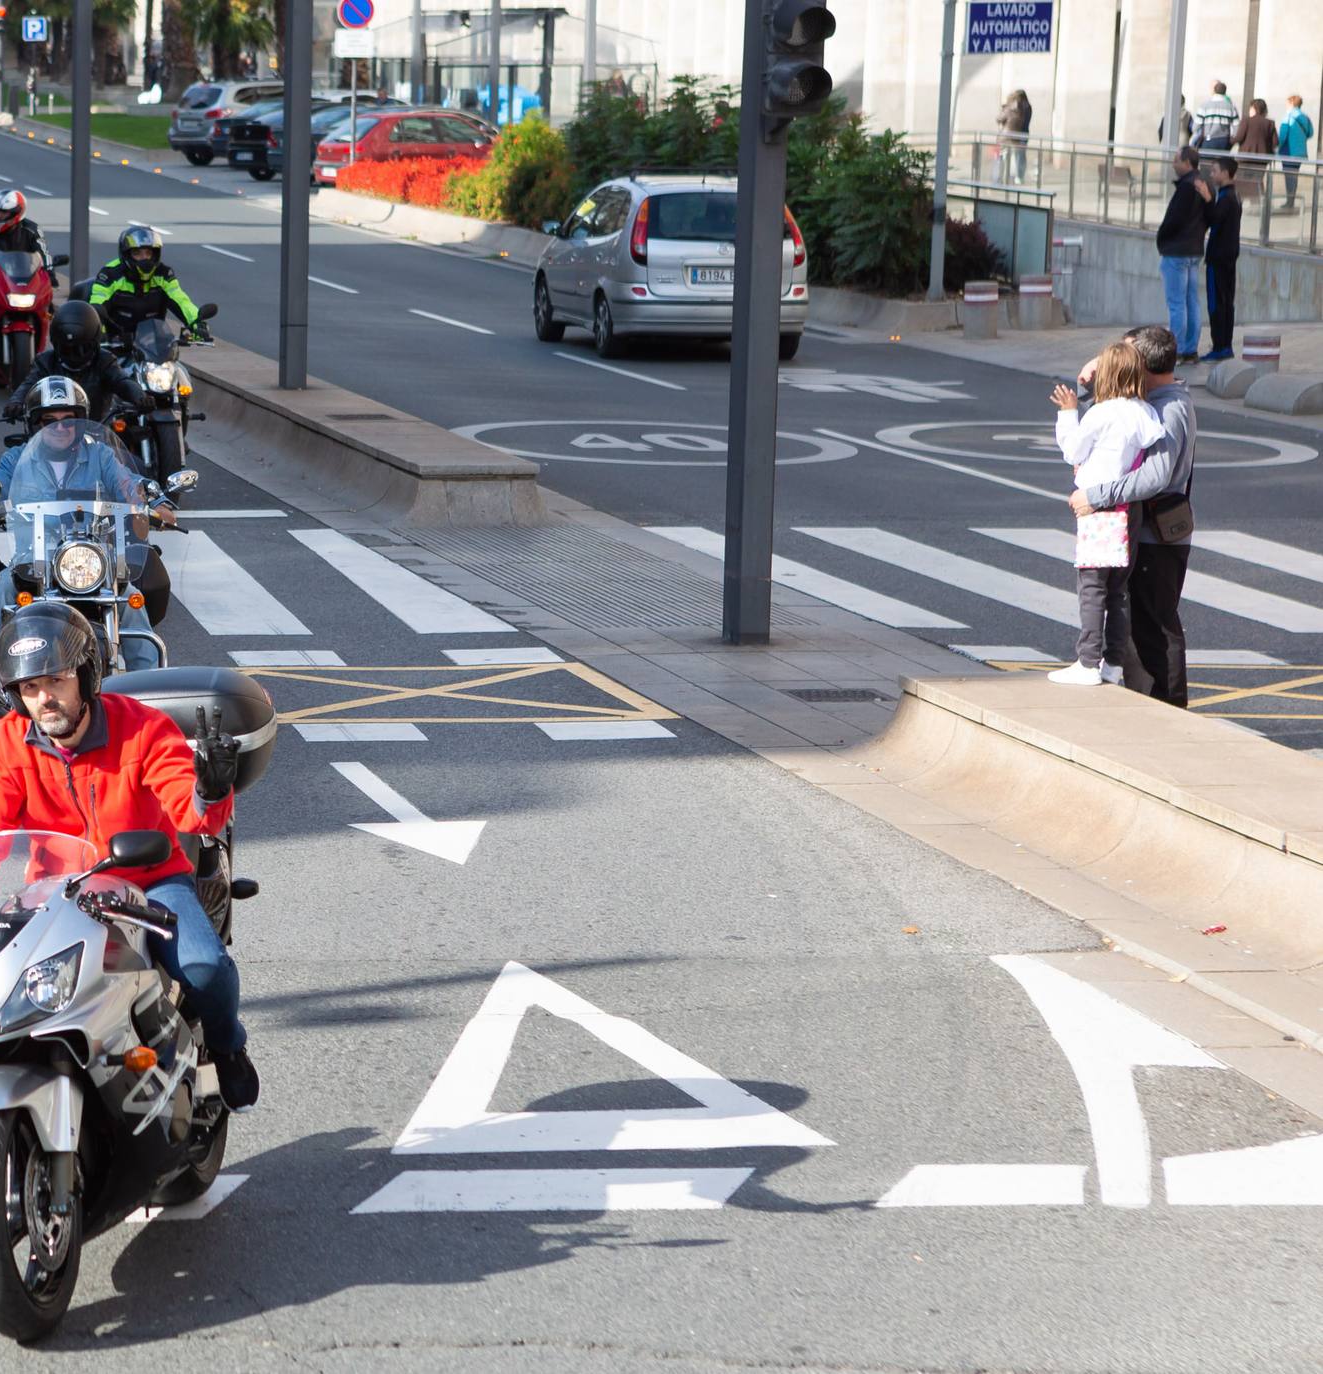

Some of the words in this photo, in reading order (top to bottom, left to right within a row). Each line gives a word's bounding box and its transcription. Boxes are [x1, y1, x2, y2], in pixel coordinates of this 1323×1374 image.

[987, 4, 1036, 17] LAVADO
[28, 20, 41, 39] P
[971, 18, 1049, 35] AUTOMÁTICO
[973, 40, 980, 52] Y
[983, 39, 992, 52] A
[995, 36, 1046, 52] PRESIÓN
[569, 433, 728, 451] 40
